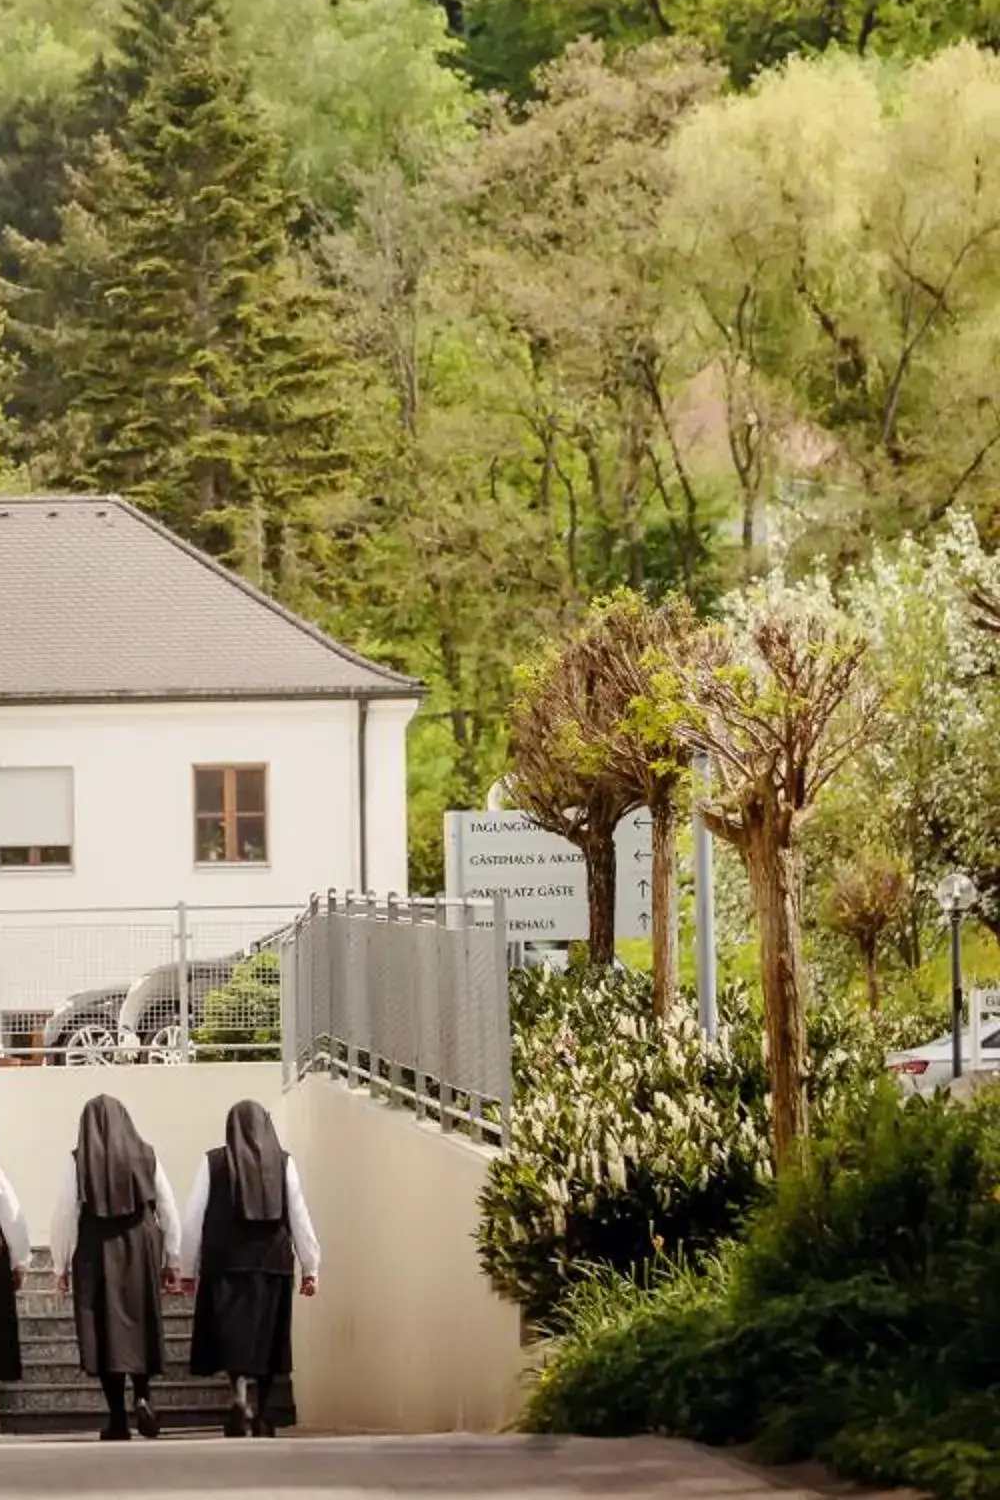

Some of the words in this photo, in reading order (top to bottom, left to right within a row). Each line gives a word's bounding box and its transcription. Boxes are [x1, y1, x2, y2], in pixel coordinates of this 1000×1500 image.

[537, 854, 545, 864] &
[549, 852, 585, 864] AKADE
[537, 883, 575, 898] GÄSTE
